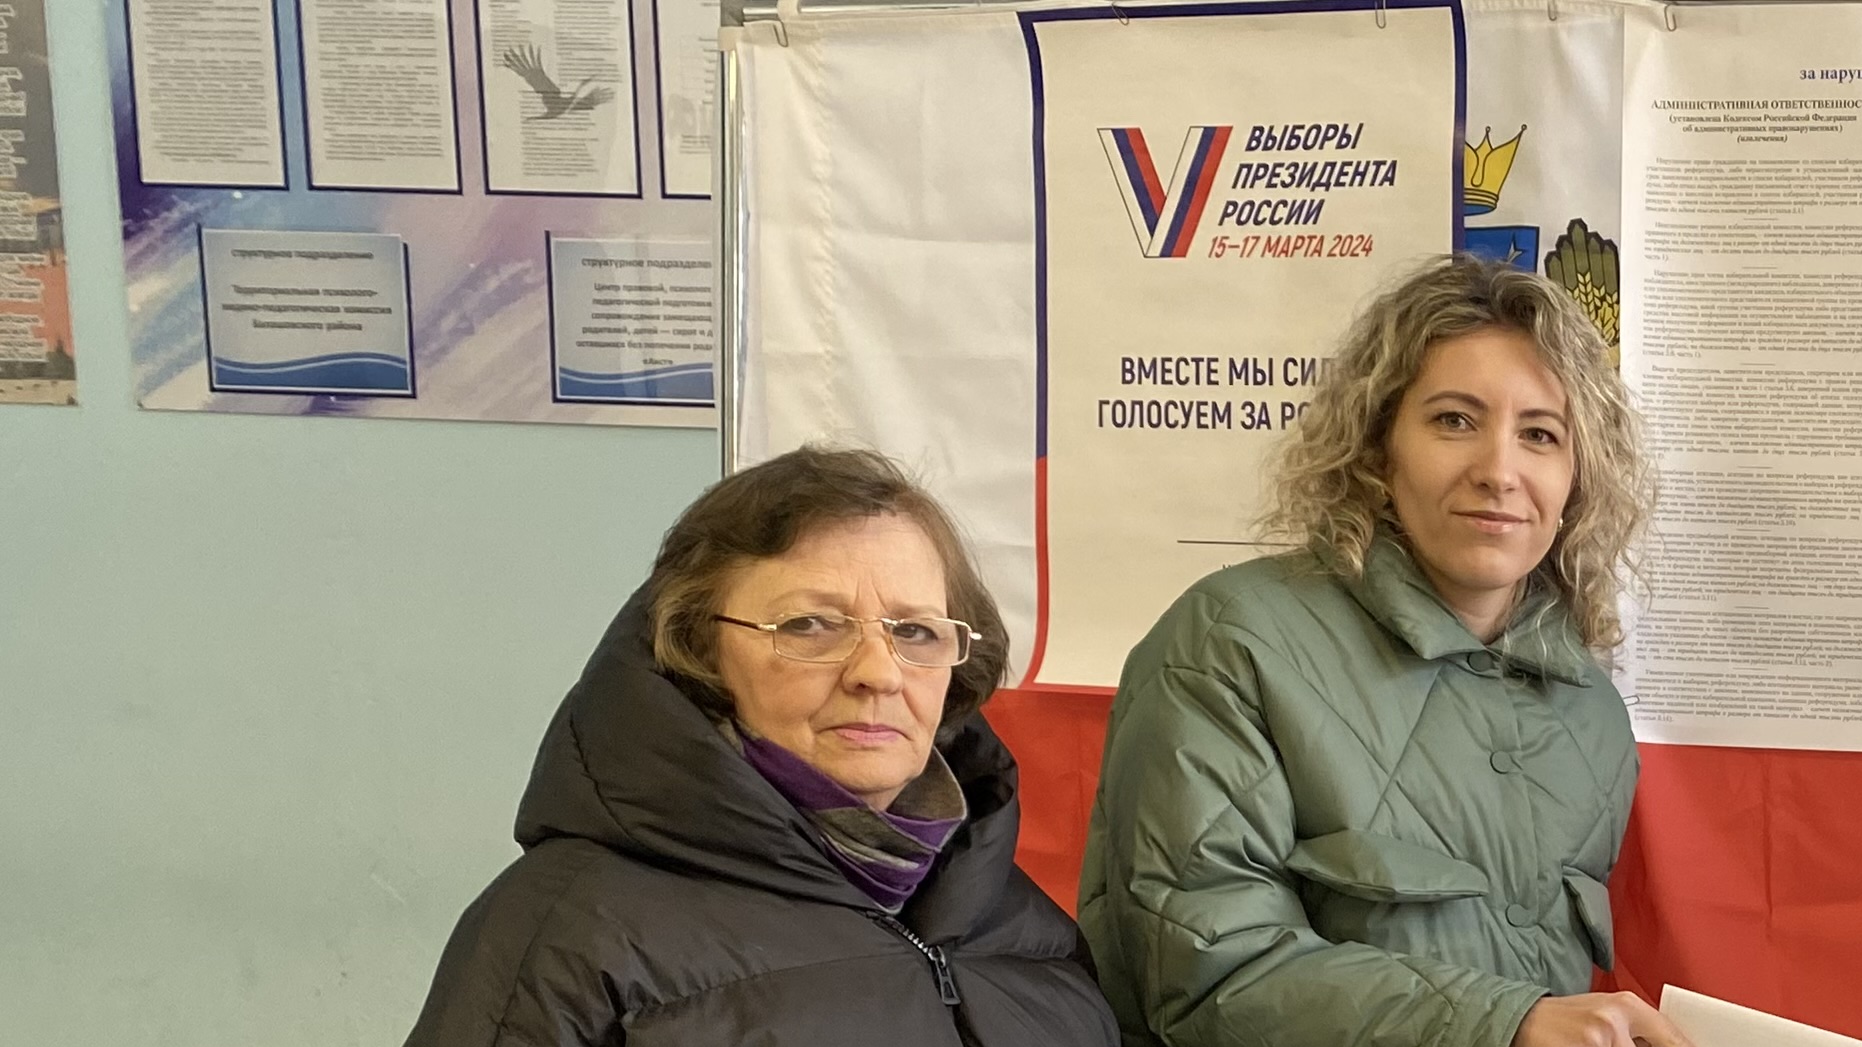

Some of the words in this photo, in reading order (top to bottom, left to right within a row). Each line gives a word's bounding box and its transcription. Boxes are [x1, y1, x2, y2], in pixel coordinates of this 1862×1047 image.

[1799, 69, 1816, 81] за
[1652, 99, 1768, 109] АДМИНИСТРАТИВНАЯ
[1245, 123, 1364, 152] ВЫБОРЫ
[1231, 160, 1398, 191] ПРЕЗИДЕНТА
[1218, 199, 1325, 226] РОССИИ
[1261, 235, 1324, 258] МАРТА
[1327, 234, 1373, 257] 2024
[1121, 357, 1219, 386] ВМЕСТЕ
[1228, 358, 1273, 387] МЫ
[1098, 400, 1232, 430] ГОЛОСУЕМ
[1240, 401, 1272, 430] ЗА
